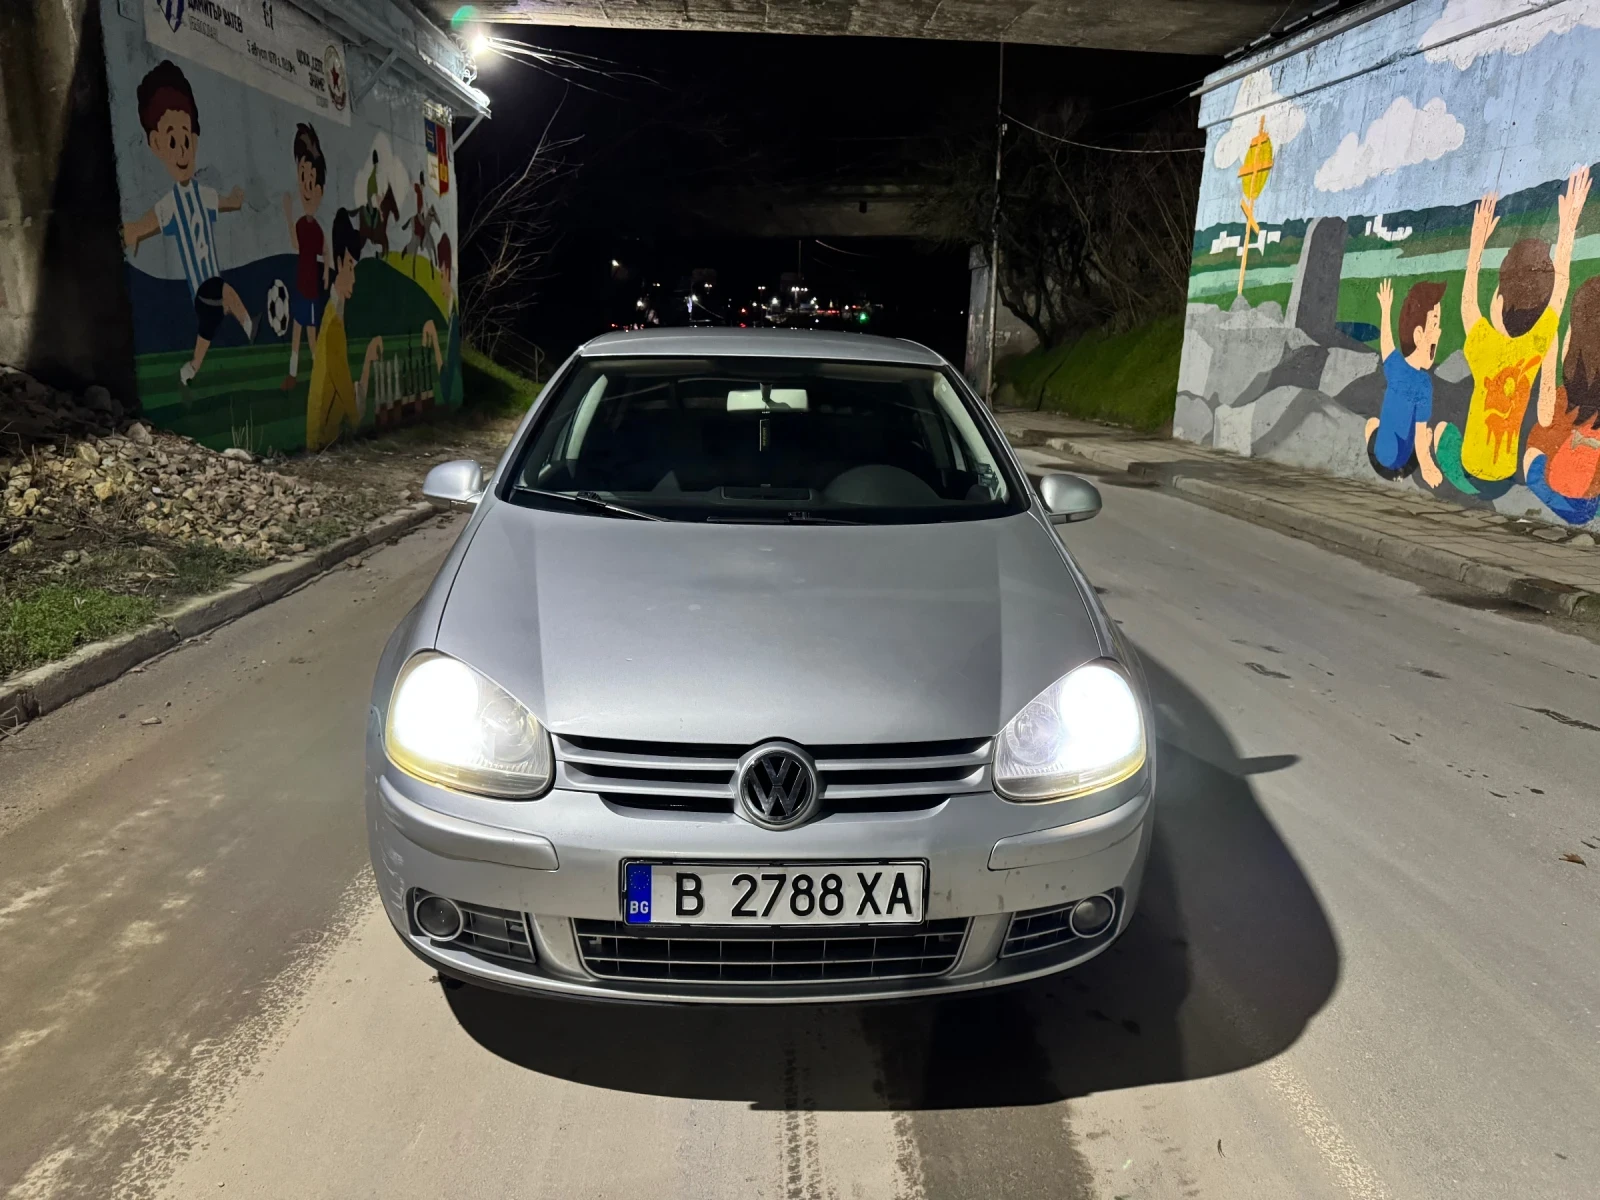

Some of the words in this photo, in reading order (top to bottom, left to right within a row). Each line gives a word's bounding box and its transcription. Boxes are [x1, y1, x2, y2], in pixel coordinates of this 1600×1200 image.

[745, 754, 807, 818] VW
[629, 901, 649, 914] BG
[675, 872, 704, 916] B
[731, 873, 844, 917] 2788
[856, 872, 913, 916] XA
